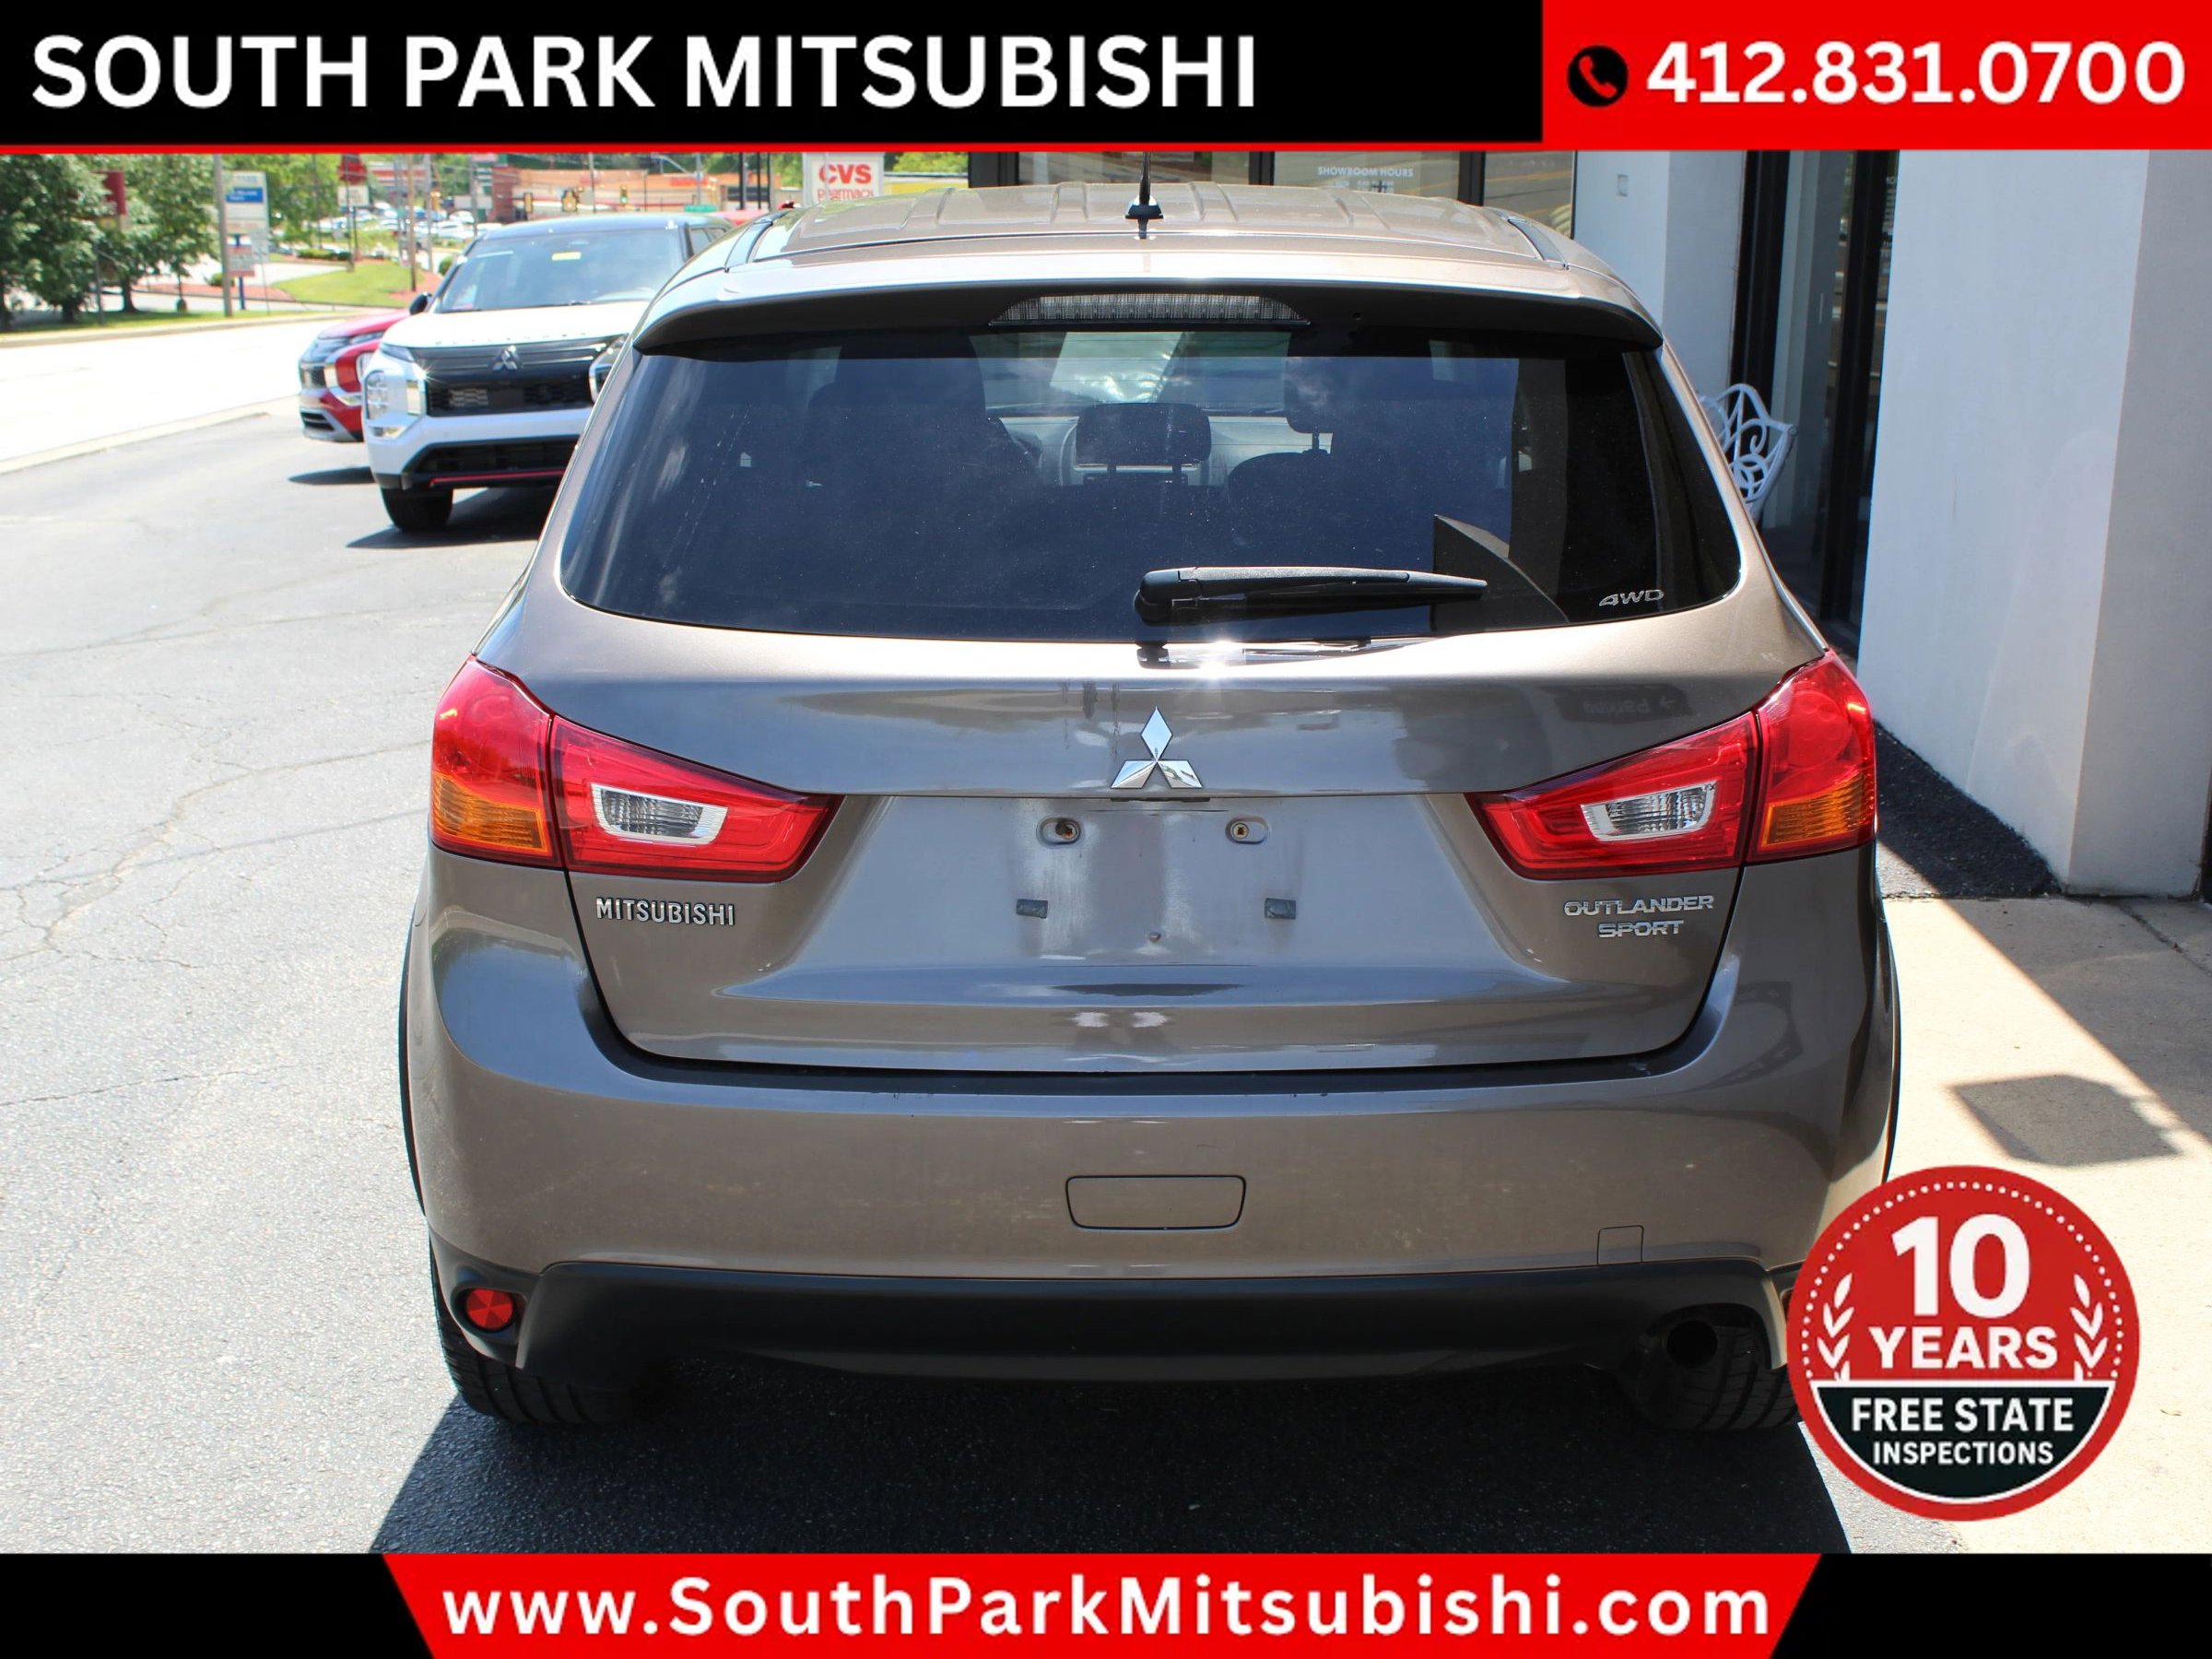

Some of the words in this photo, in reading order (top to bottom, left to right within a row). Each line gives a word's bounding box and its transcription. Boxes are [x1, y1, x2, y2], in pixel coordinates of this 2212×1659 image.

[818, 164, 872, 184] CVS
[1317, 167, 1379, 177] SHOWROOM
[1380, 168, 1414, 177] HOURS
[1598, 589, 1665, 606] 4WD
[595, 897, 735, 926] MITSUBISHI
[1563, 894, 1714, 916] OUTLANDER
[1597, 919, 1685, 938] SPORT
